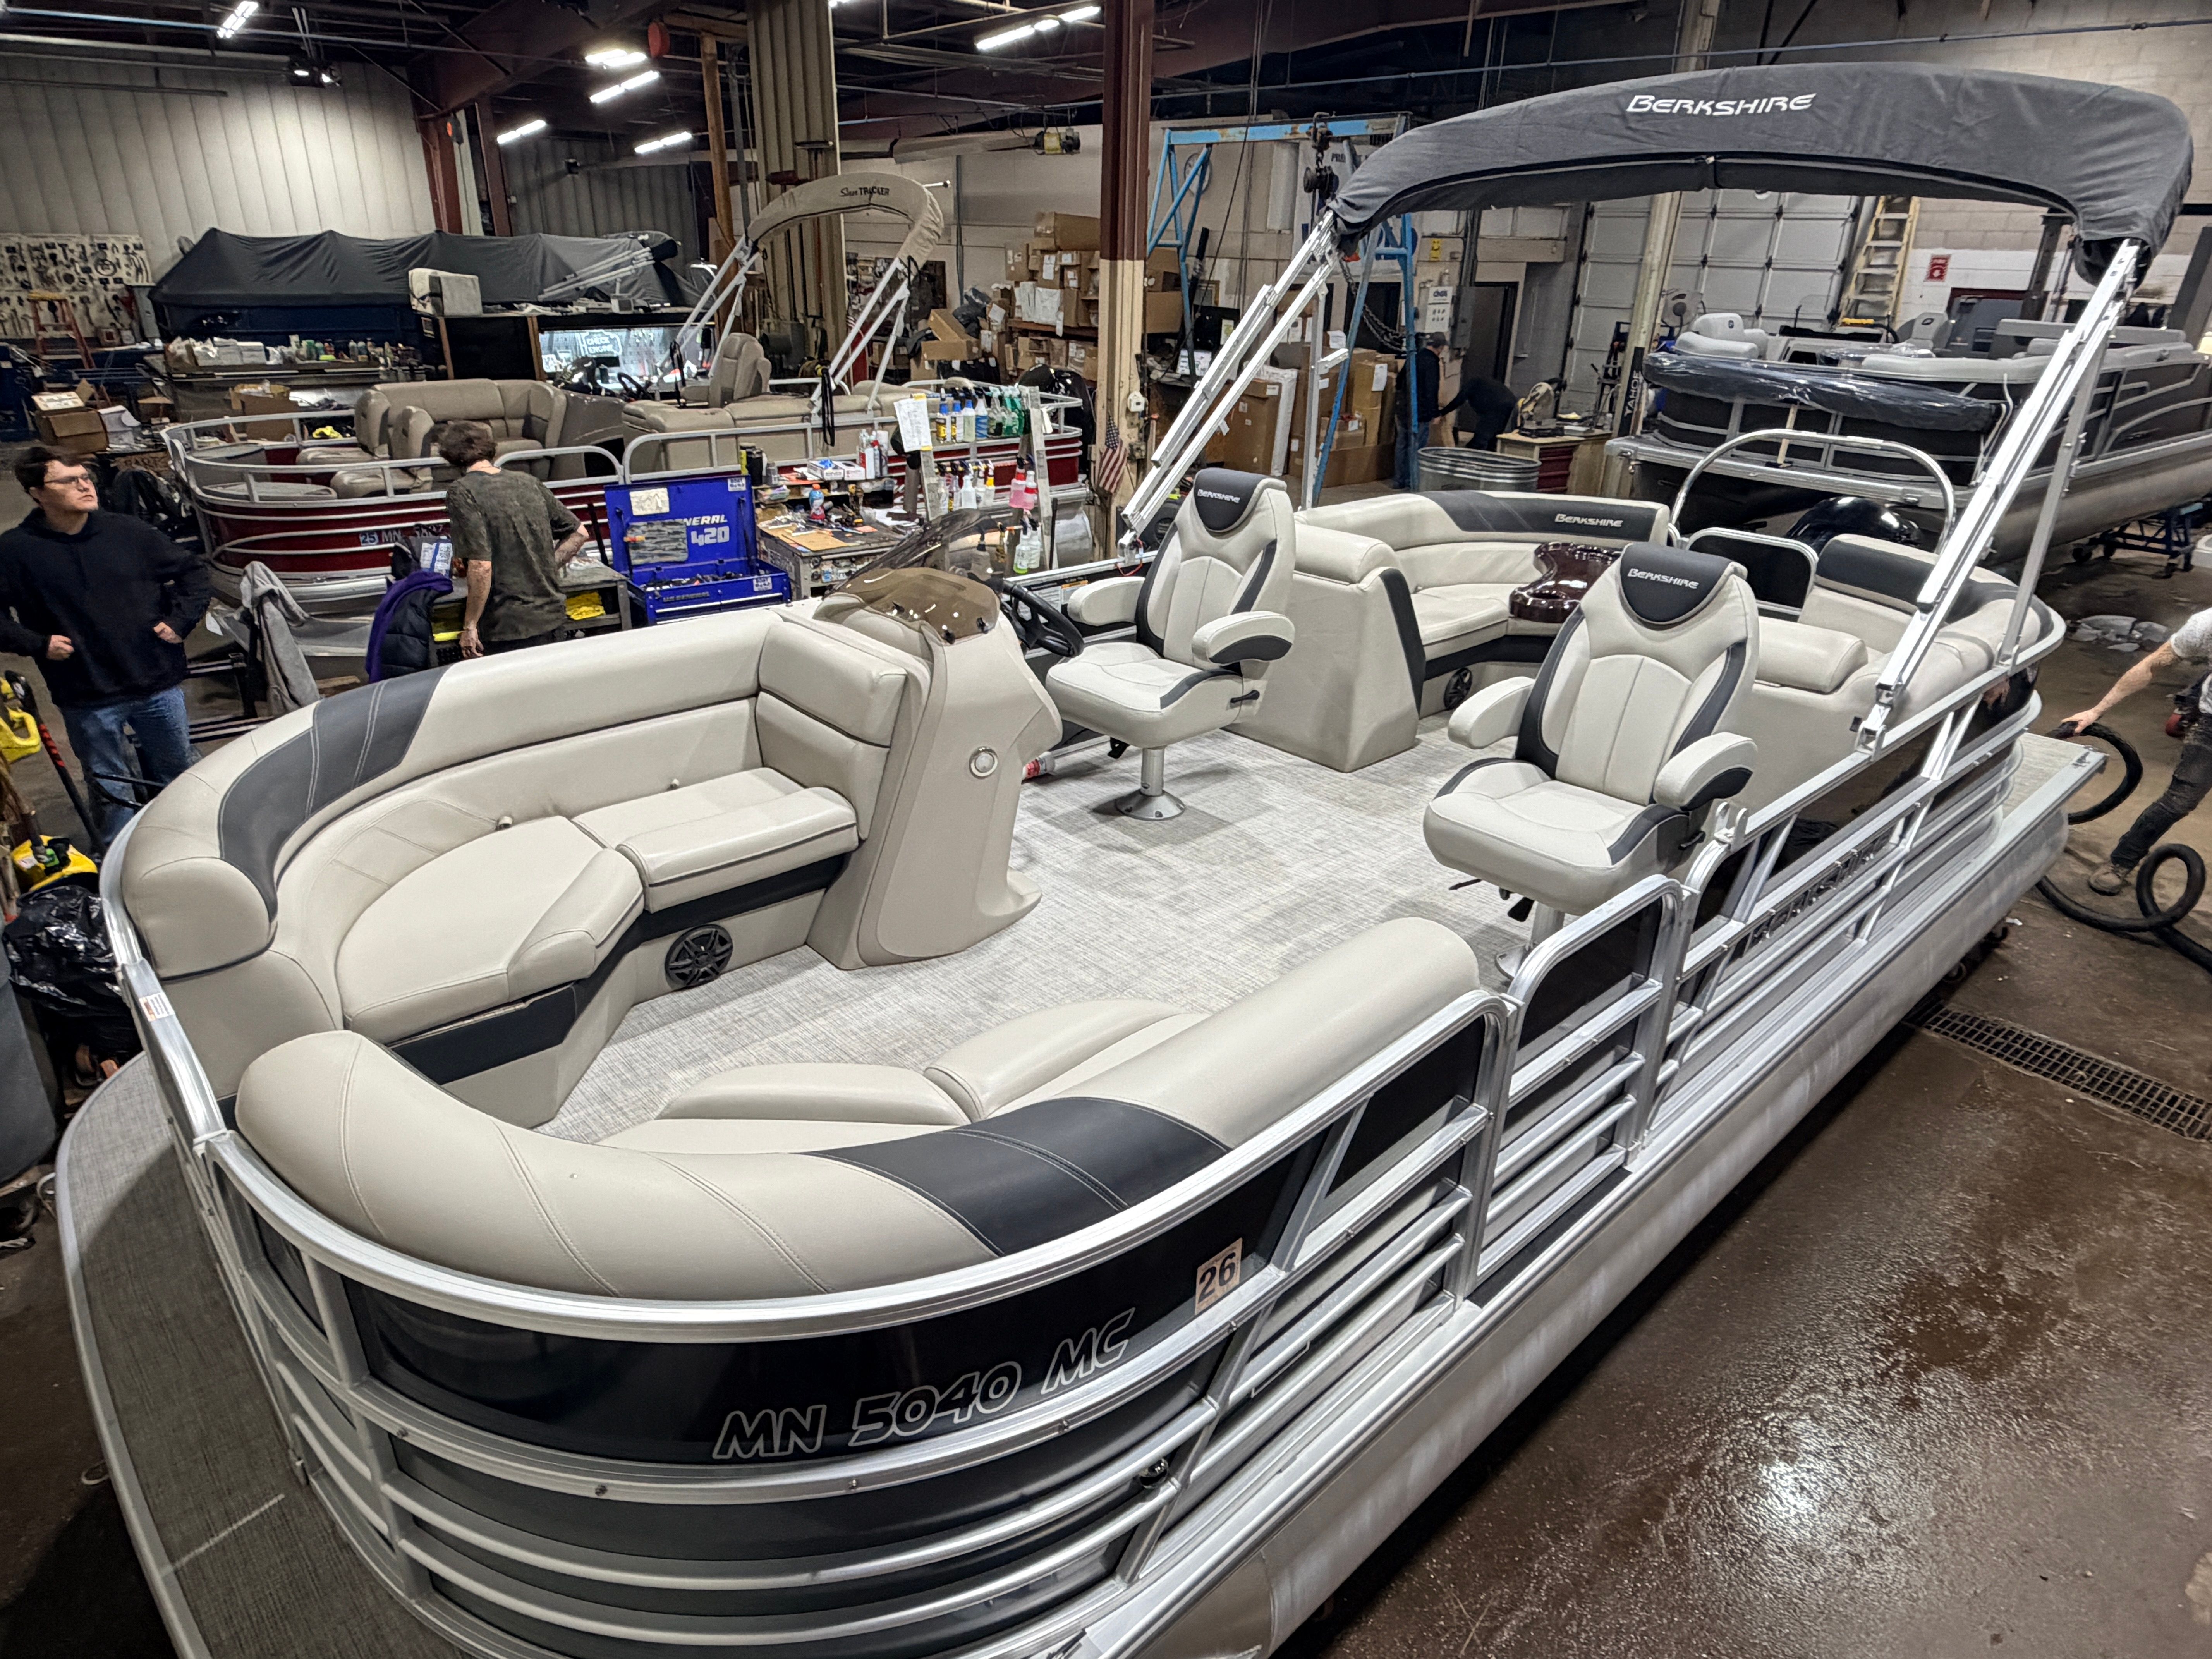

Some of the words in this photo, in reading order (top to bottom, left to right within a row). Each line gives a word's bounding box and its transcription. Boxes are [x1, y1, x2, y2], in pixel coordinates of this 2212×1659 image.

[1626, 93, 1817, 116] BERKSHIRE
[839, 187, 857, 197] Sun
[1197, 489, 1241, 504] BERKSHIRE
[673, 514, 728, 526] NERAL
[1554, 513, 1624, 527] BERKSHIRE
[361, 532, 377, 543] 25
[690, 526, 730, 546] 420
[1627, 568, 1700, 589] BERKSHIRE
[1198, 1252, 1236, 1304] 26
[712, 1404, 827, 1459] MN
[848, 1361, 1022, 1446] 5040
[1040, 1306, 1136, 1394] MC
